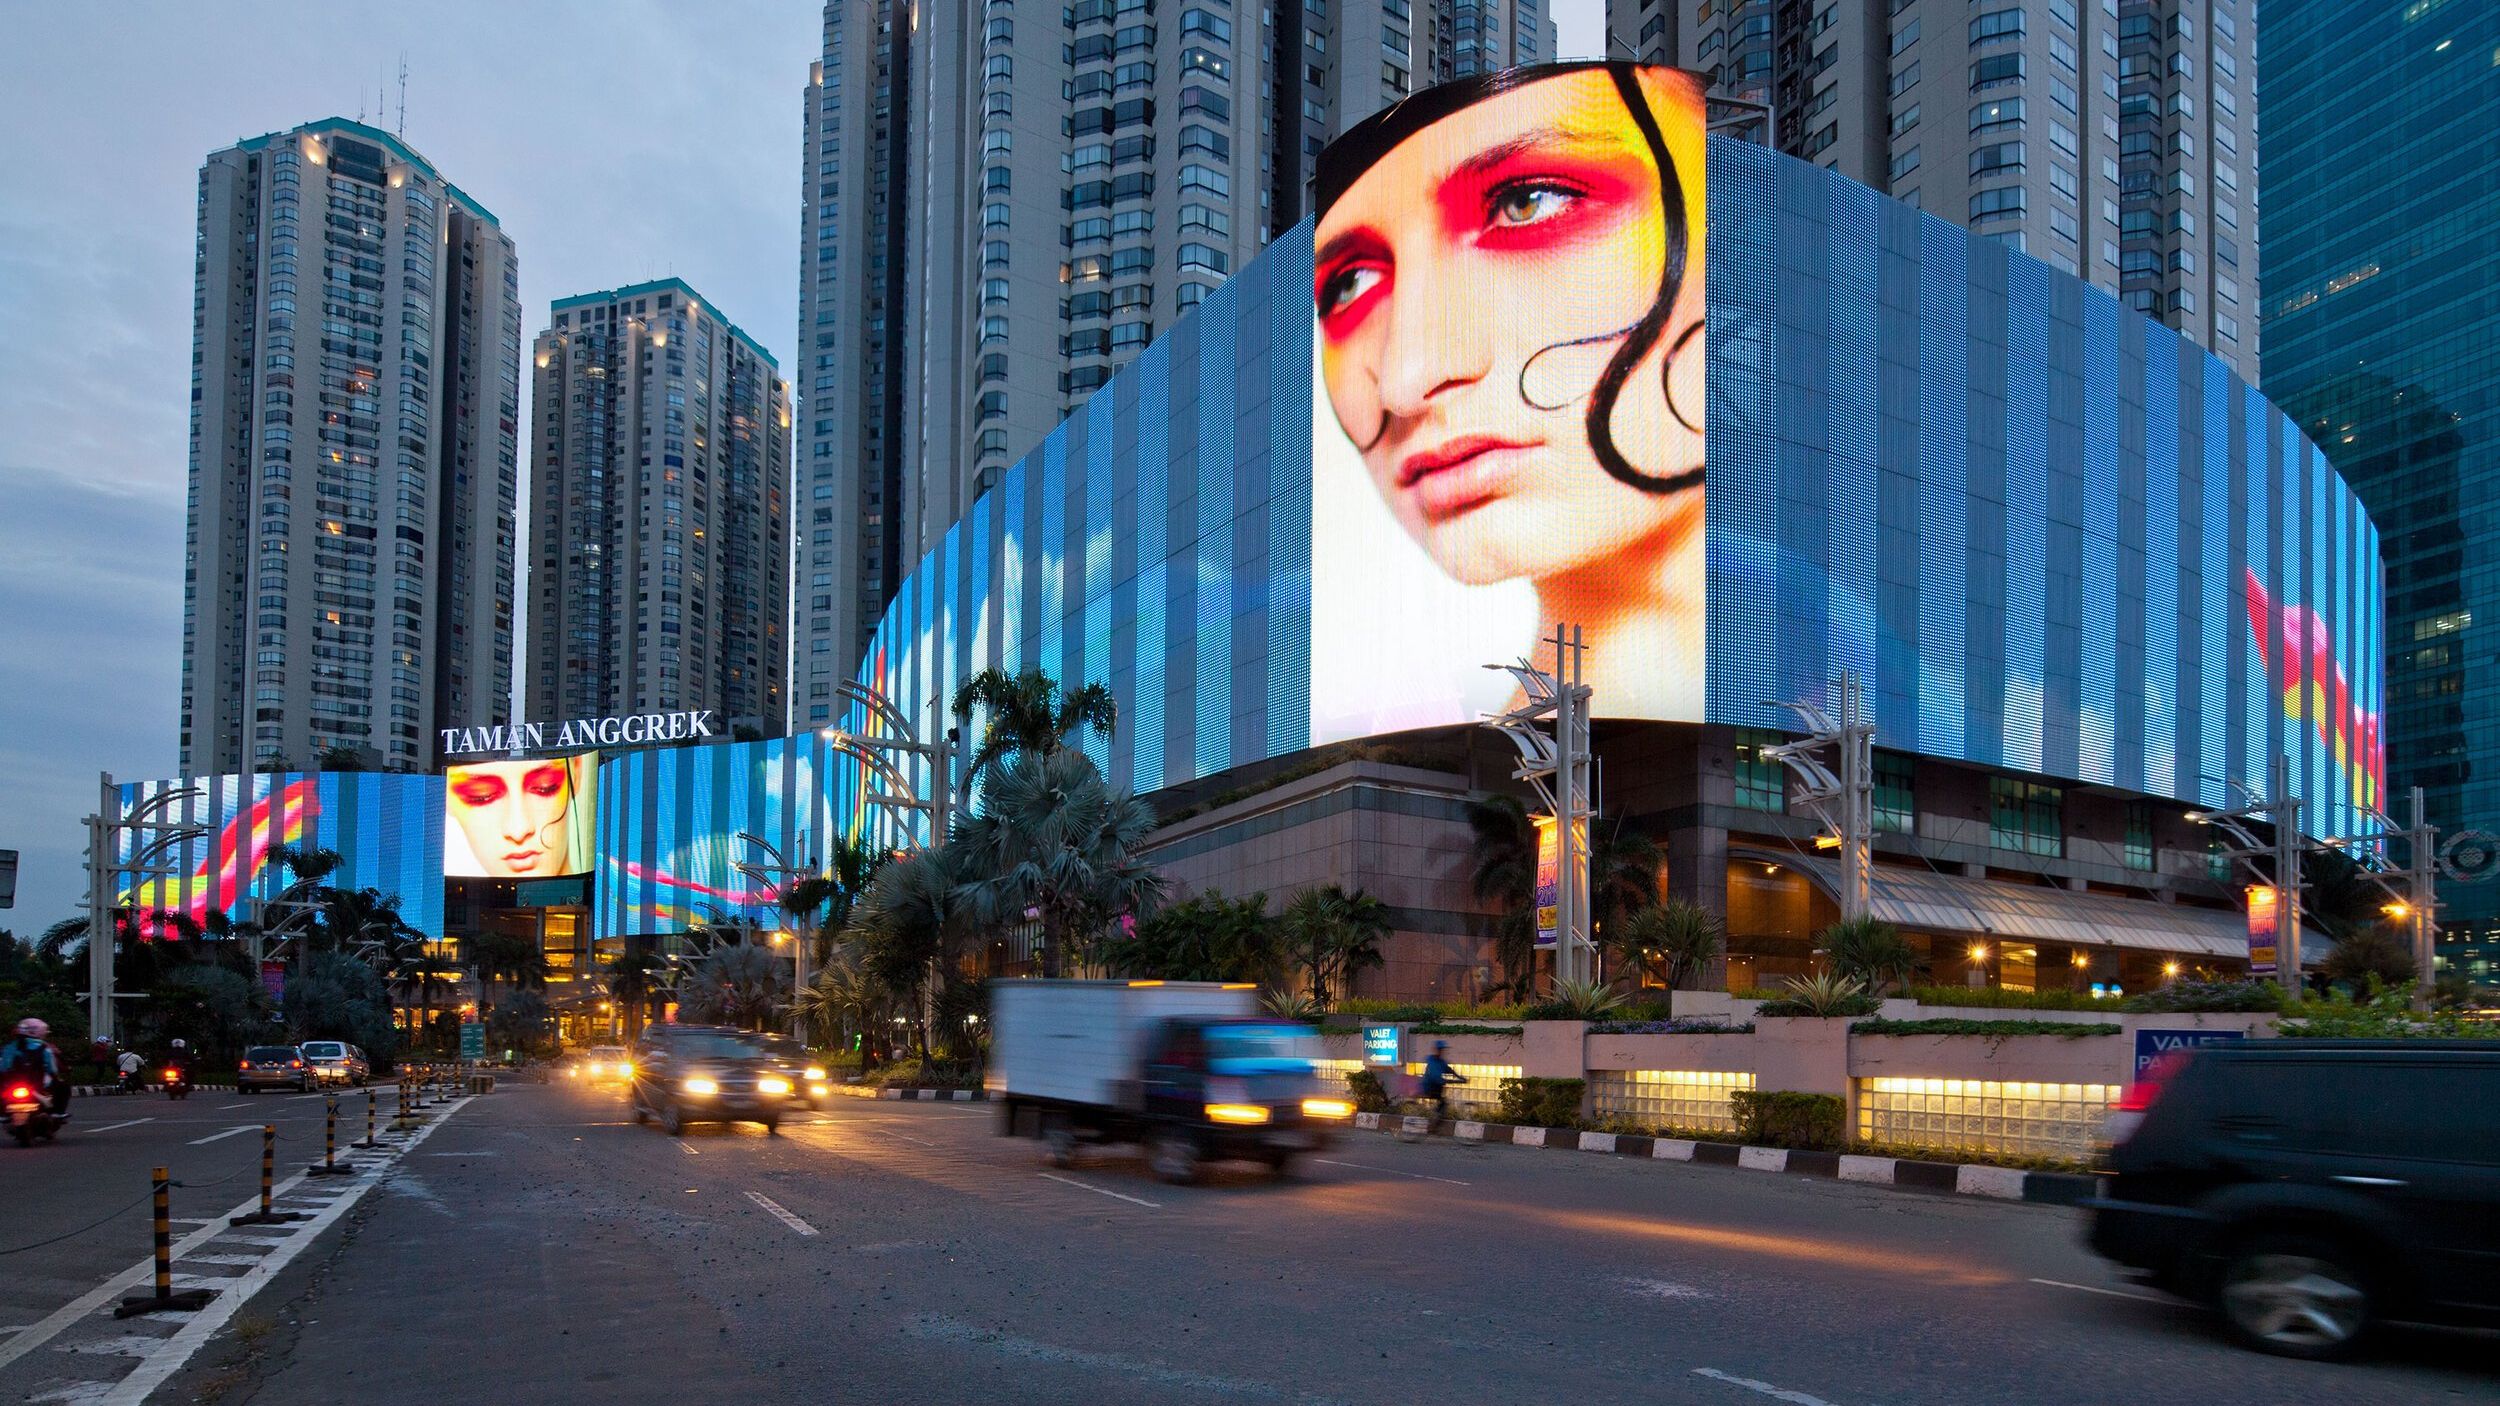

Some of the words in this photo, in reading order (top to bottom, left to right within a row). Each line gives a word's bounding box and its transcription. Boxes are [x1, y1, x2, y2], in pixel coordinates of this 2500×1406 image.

[441, 722, 545, 754] TAMAN
[556, 710, 712, 747] ANGGREK
[1370, 1028, 1392, 1038] VALET
[1364, 1040, 1397, 1049] PARKING
[2152, 1036, 2226, 1051] VALE
